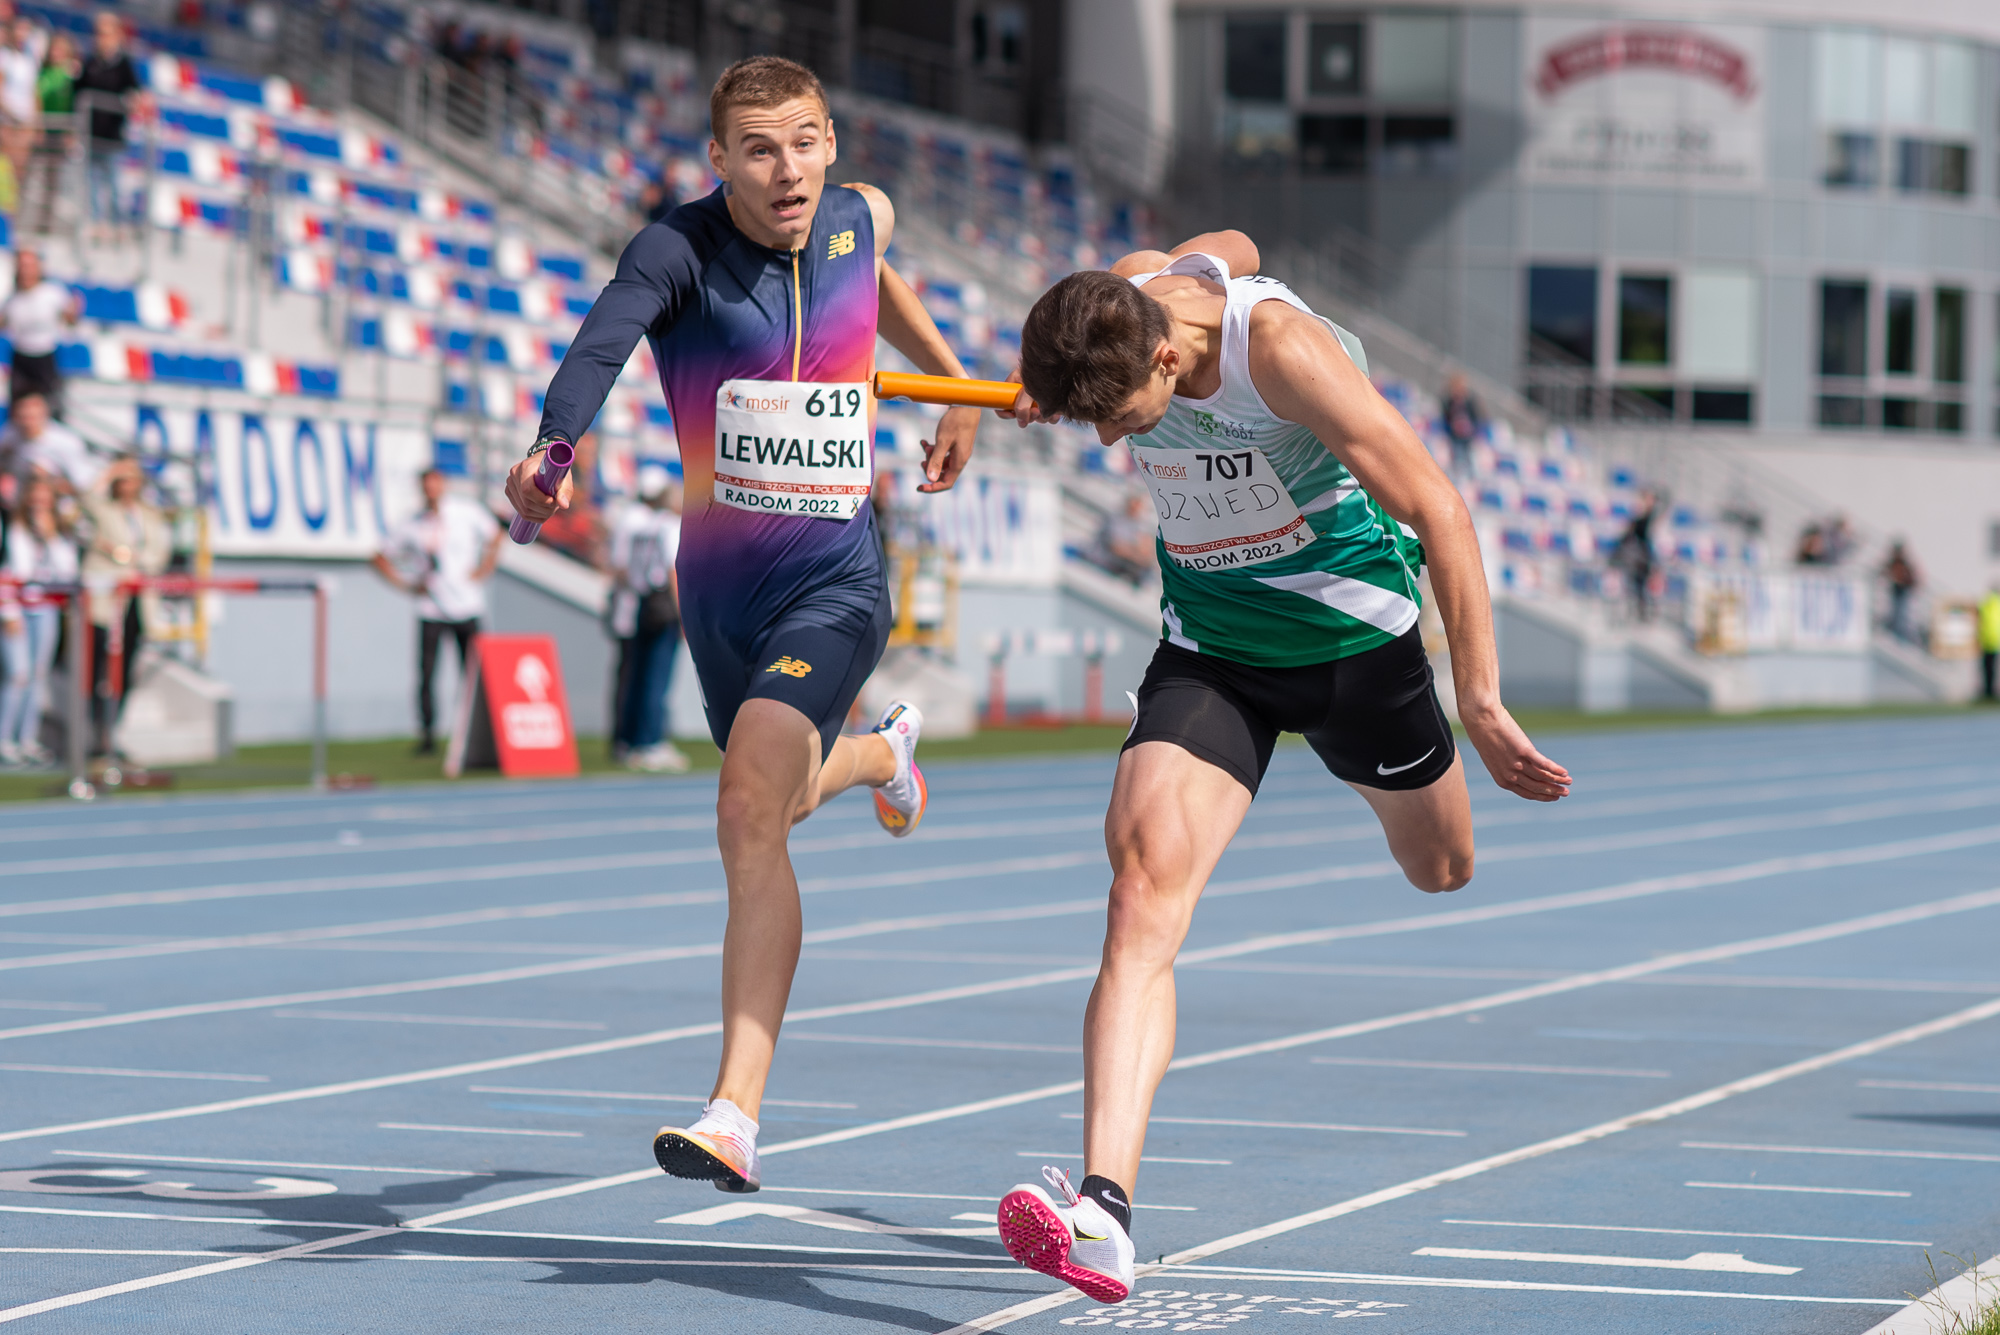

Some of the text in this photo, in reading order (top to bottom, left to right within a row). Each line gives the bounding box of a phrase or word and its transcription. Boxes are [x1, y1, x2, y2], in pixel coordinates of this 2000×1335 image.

[746, 396, 790, 411] mosir
[805, 389, 861, 417] 619
[720, 432, 864, 469] LEWALSKI
[1153, 462, 1187, 478] mosir
[1195, 452, 1253, 481] 707
[717, 474, 868, 495] PZLA MISTRZOSTWA POLSKI U20
[725, 488, 839, 513] RADOM 2022
[1157, 483, 1279, 521] SZWED
[1183, 537, 1248, 553] MISTRZOSTWA
[1248, 529, 1282, 543] POLSKI
[1282, 518, 1303, 533] U20
[1242, 543, 1285, 561] 2022
